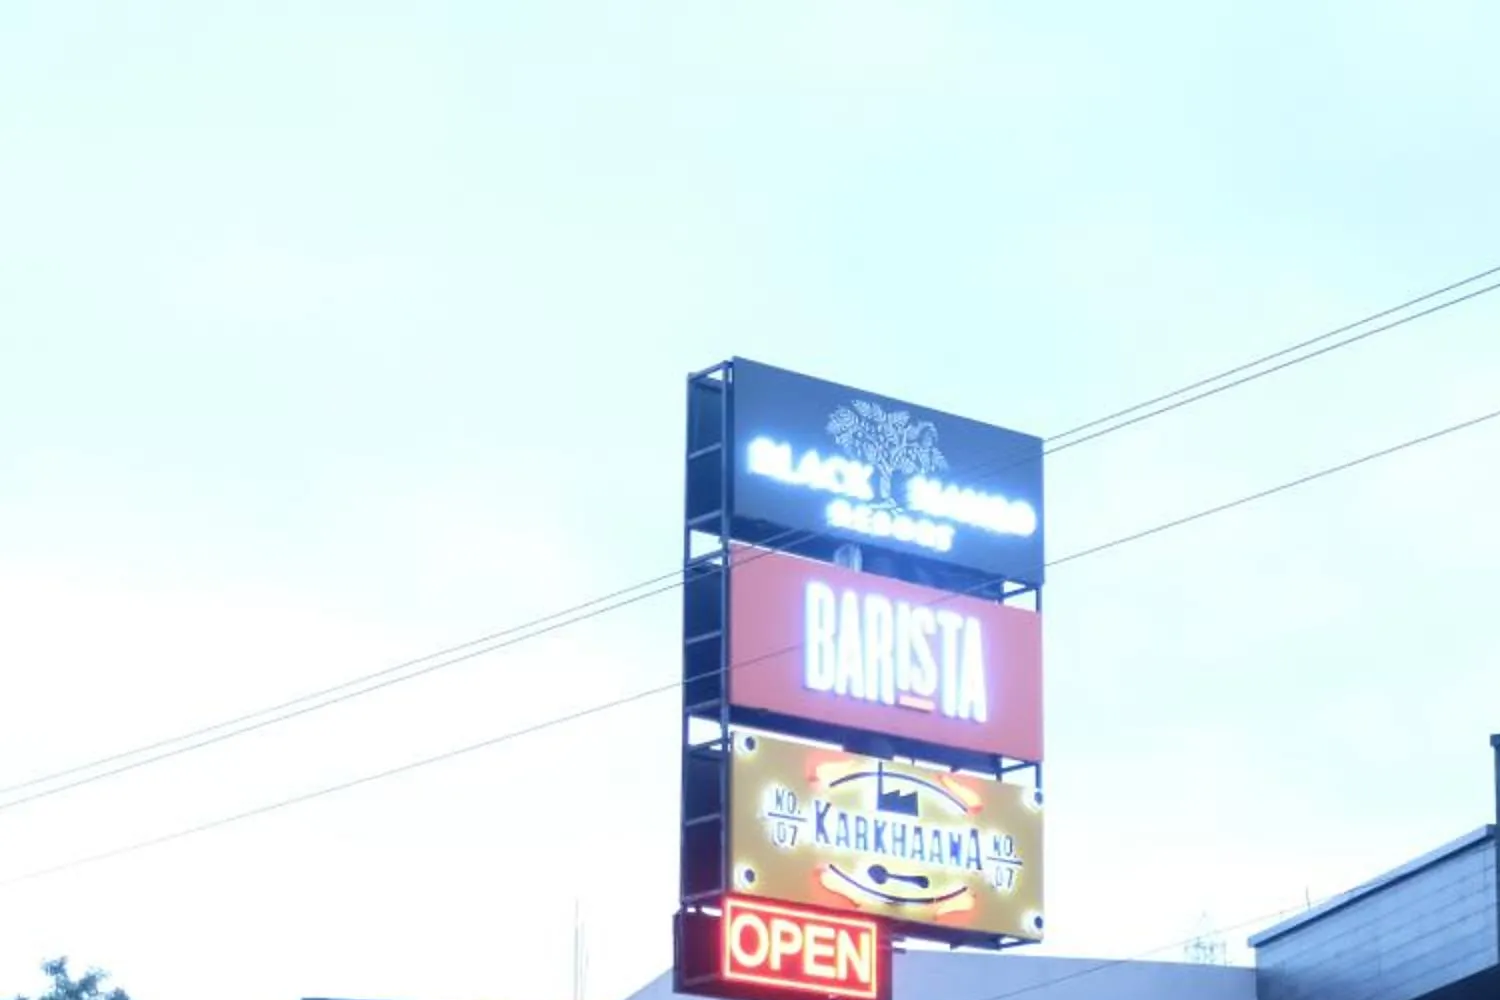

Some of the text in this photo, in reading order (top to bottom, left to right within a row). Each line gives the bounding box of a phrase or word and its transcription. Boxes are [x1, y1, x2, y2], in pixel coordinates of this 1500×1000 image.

[804, 580, 988, 723] BARISTA
[814, 799, 983, 871] KARKHAANA
[730, 913, 870, 983] OPEN
